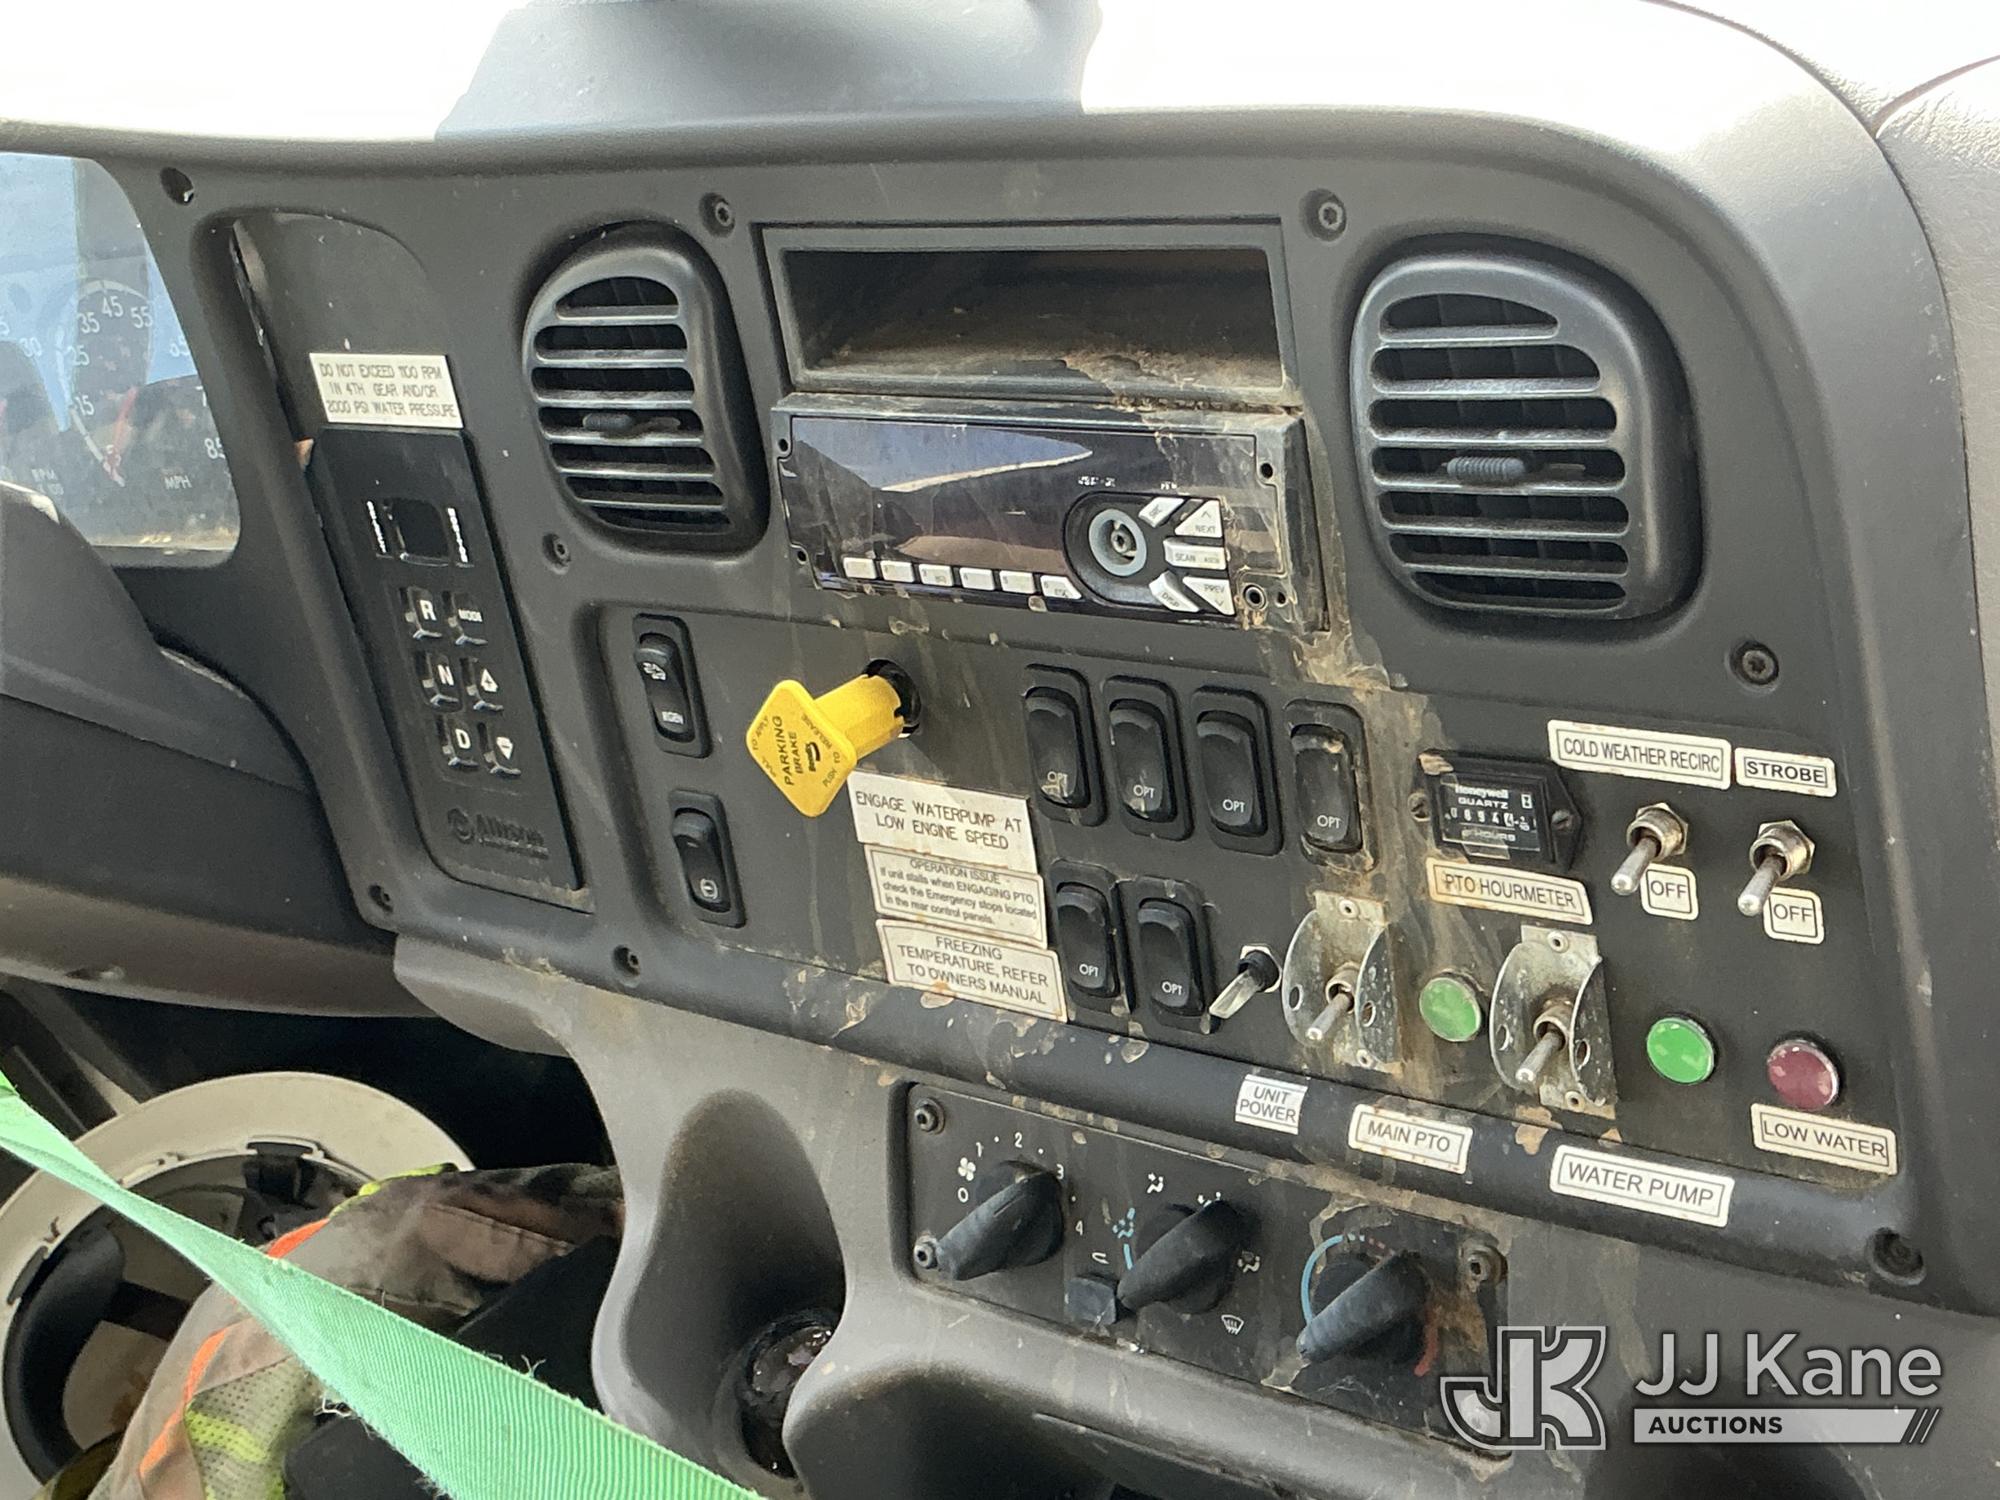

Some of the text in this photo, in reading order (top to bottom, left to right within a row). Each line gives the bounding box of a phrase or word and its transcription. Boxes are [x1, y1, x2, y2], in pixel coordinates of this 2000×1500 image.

[102, 296, 124, 318] 45
[131, 306, 153, 329] 55
[78, 312, 100, 334] 35
[319, 363, 334, 378] DO
[337, 364, 356, 378] NOT
[359, 365, 396, 379] EXCEED
[421, 366, 443, 380] RPM
[329, 382, 439, 399] IN 4TH GEAR AND/OR
[75, 395, 95, 416] 15
[326, 400, 458, 419] 2000 PSI WATER PRESSURE
[164, 475, 193, 490] MPH
[1195, 525, 1217, 534] NEXT
[1175, 553, 1197, 563] SCAN
[1204, 584, 1225, 594] PREV
[419, 599, 437, 621] R
[437, 664, 455, 686] N
[455, 728, 471, 749] D
[772, 715, 796, 786] PARKING
[788, 731, 804, 774] BRAKE
[1563, 738, 1721, 772] COLD WEATHER RECIRC
[1047, 770, 1069, 785] OPT
[1746, 760, 1826, 784] STROBE
[1132, 784, 1155, 799] OPT
[1455, 785, 1509, 799] Honeywell
[855, 790, 1022, 834] ENGAGE WATERPUMP AT
[1222, 799, 1246, 813] OPT
[1457, 796, 1509, 810] QUARTZ
[875, 812, 1010, 850] LOW ENGINE SPEED
[1317, 814, 1341, 829] OPT
[909, 858, 1000, 885] OPERATION ISSUE
[888, 869, 904, 880] unit
[906, 871, 929, 885] stalls
[931, 876, 955, 892] when
[956, 881, 1012, 901] ENGAGING
[1444, 872, 1577, 910] PTO HOURMETER
[1650, 879, 1688, 899] OFF
[883, 881, 1038, 920] check the Emergency stops located
[895, 896, 910, 908] the
[911, 901, 929, 912] rear
[931, 904, 961, 918] control
[1773, 903, 1813, 923] OFF
[935, 936, 1003, 961] FREEZING
[897, 945, 1049, 988] TEMPERATURE, REFER
[1079, 963, 1099, 978] OPT
[907, 963, 1047, 1005] TO OWNERS MANUAL
[1162, 981, 1183, 996] OPT
[1253, 1086, 1291, 1105] UNIT
[1240, 1100, 1297, 1123] POWER
[1014, 1132, 1023, 1149] 2
[1367, 1120, 1450, 1153] MAIN PTO
[1763, 1119, 1887, 1160] LOW WATER
[976, 1142, 985, 1158] 1
[1056, 1163, 1065, 1180] 3
[1568, 1161, 1714, 1207] WATER PUMP
[1075, 1220, 1084, 1236] 4
